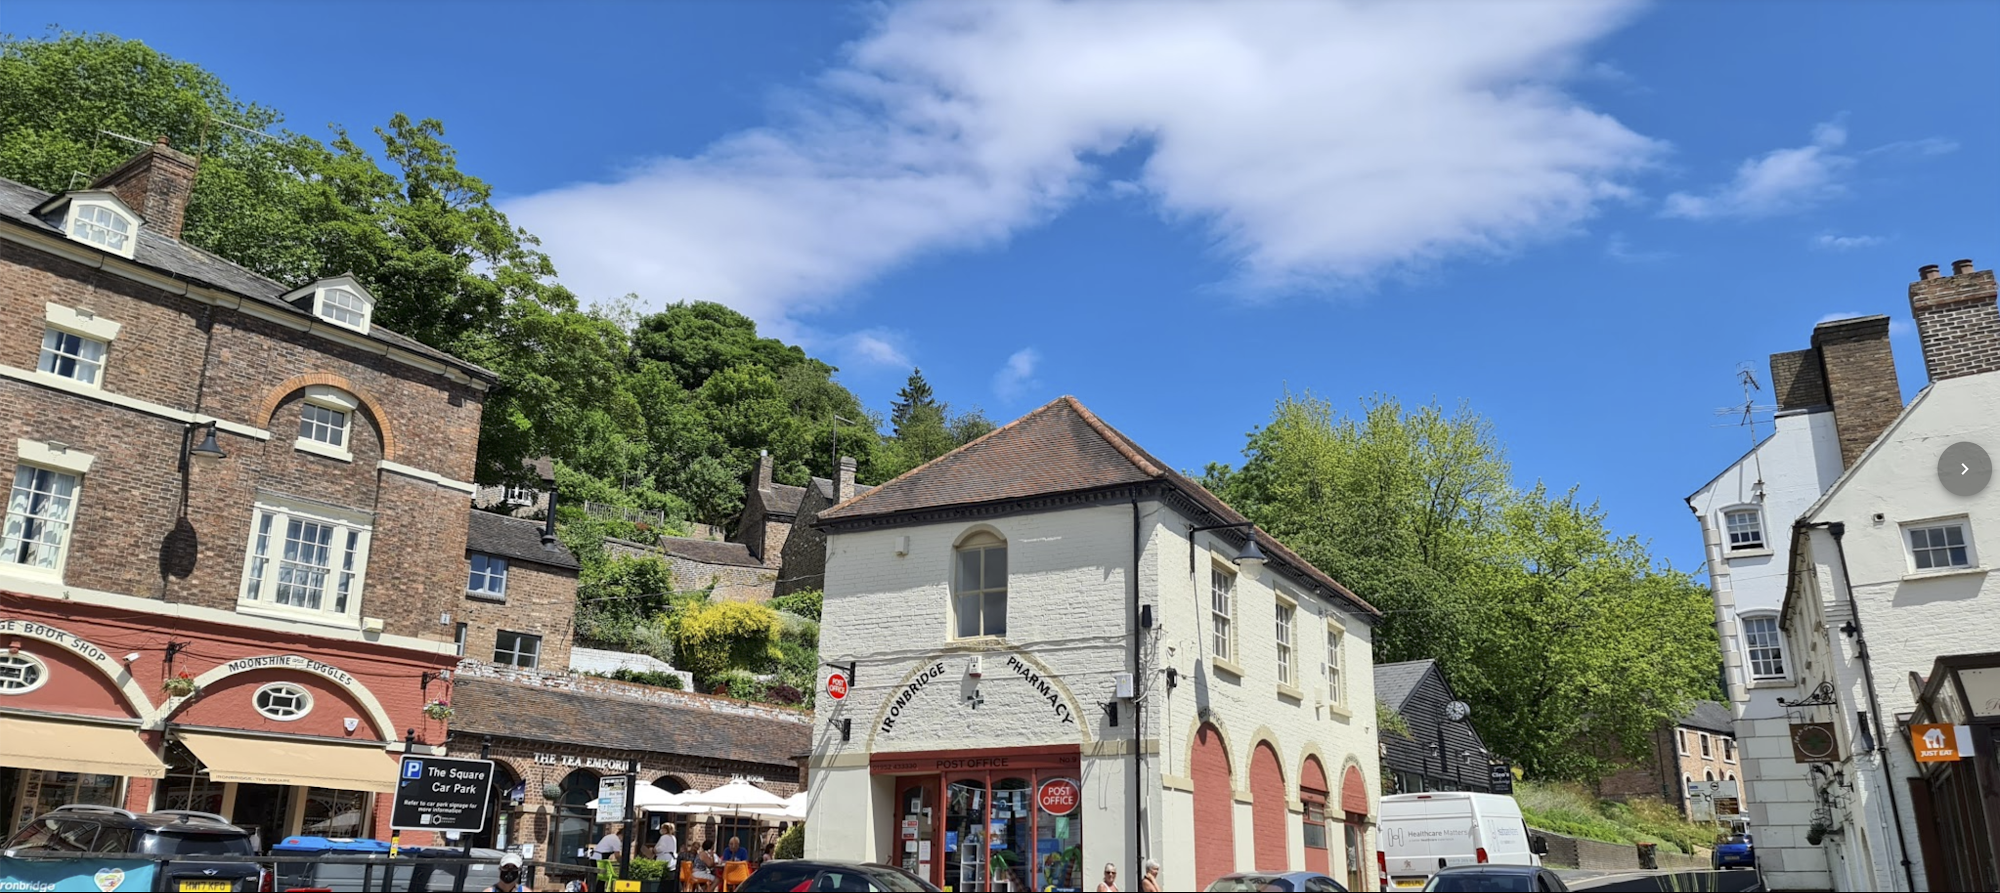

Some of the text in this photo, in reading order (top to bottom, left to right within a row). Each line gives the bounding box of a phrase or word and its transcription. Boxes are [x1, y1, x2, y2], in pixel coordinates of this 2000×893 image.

[24, 623, 64, 642] BOOK
[71, 638, 106, 661] SHOP
[228, 656, 290, 673] MOONSHINE
[832, 677, 844, 686] POST
[829, 685, 845, 694] OFFICE
[881, 656, 1074, 733] IRONBRIDGE PHARMACY
[534, 752, 556, 764] THE
[561, 755, 581, 767] TEA
[936, 757, 1008, 769] POST OFFICE
[428, 766, 485, 780] The Square
[432, 782, 476, 794] Car Park
[1048, 786, 1070, 796] POST
[1042, 796, 1074, 806] OFFICE
